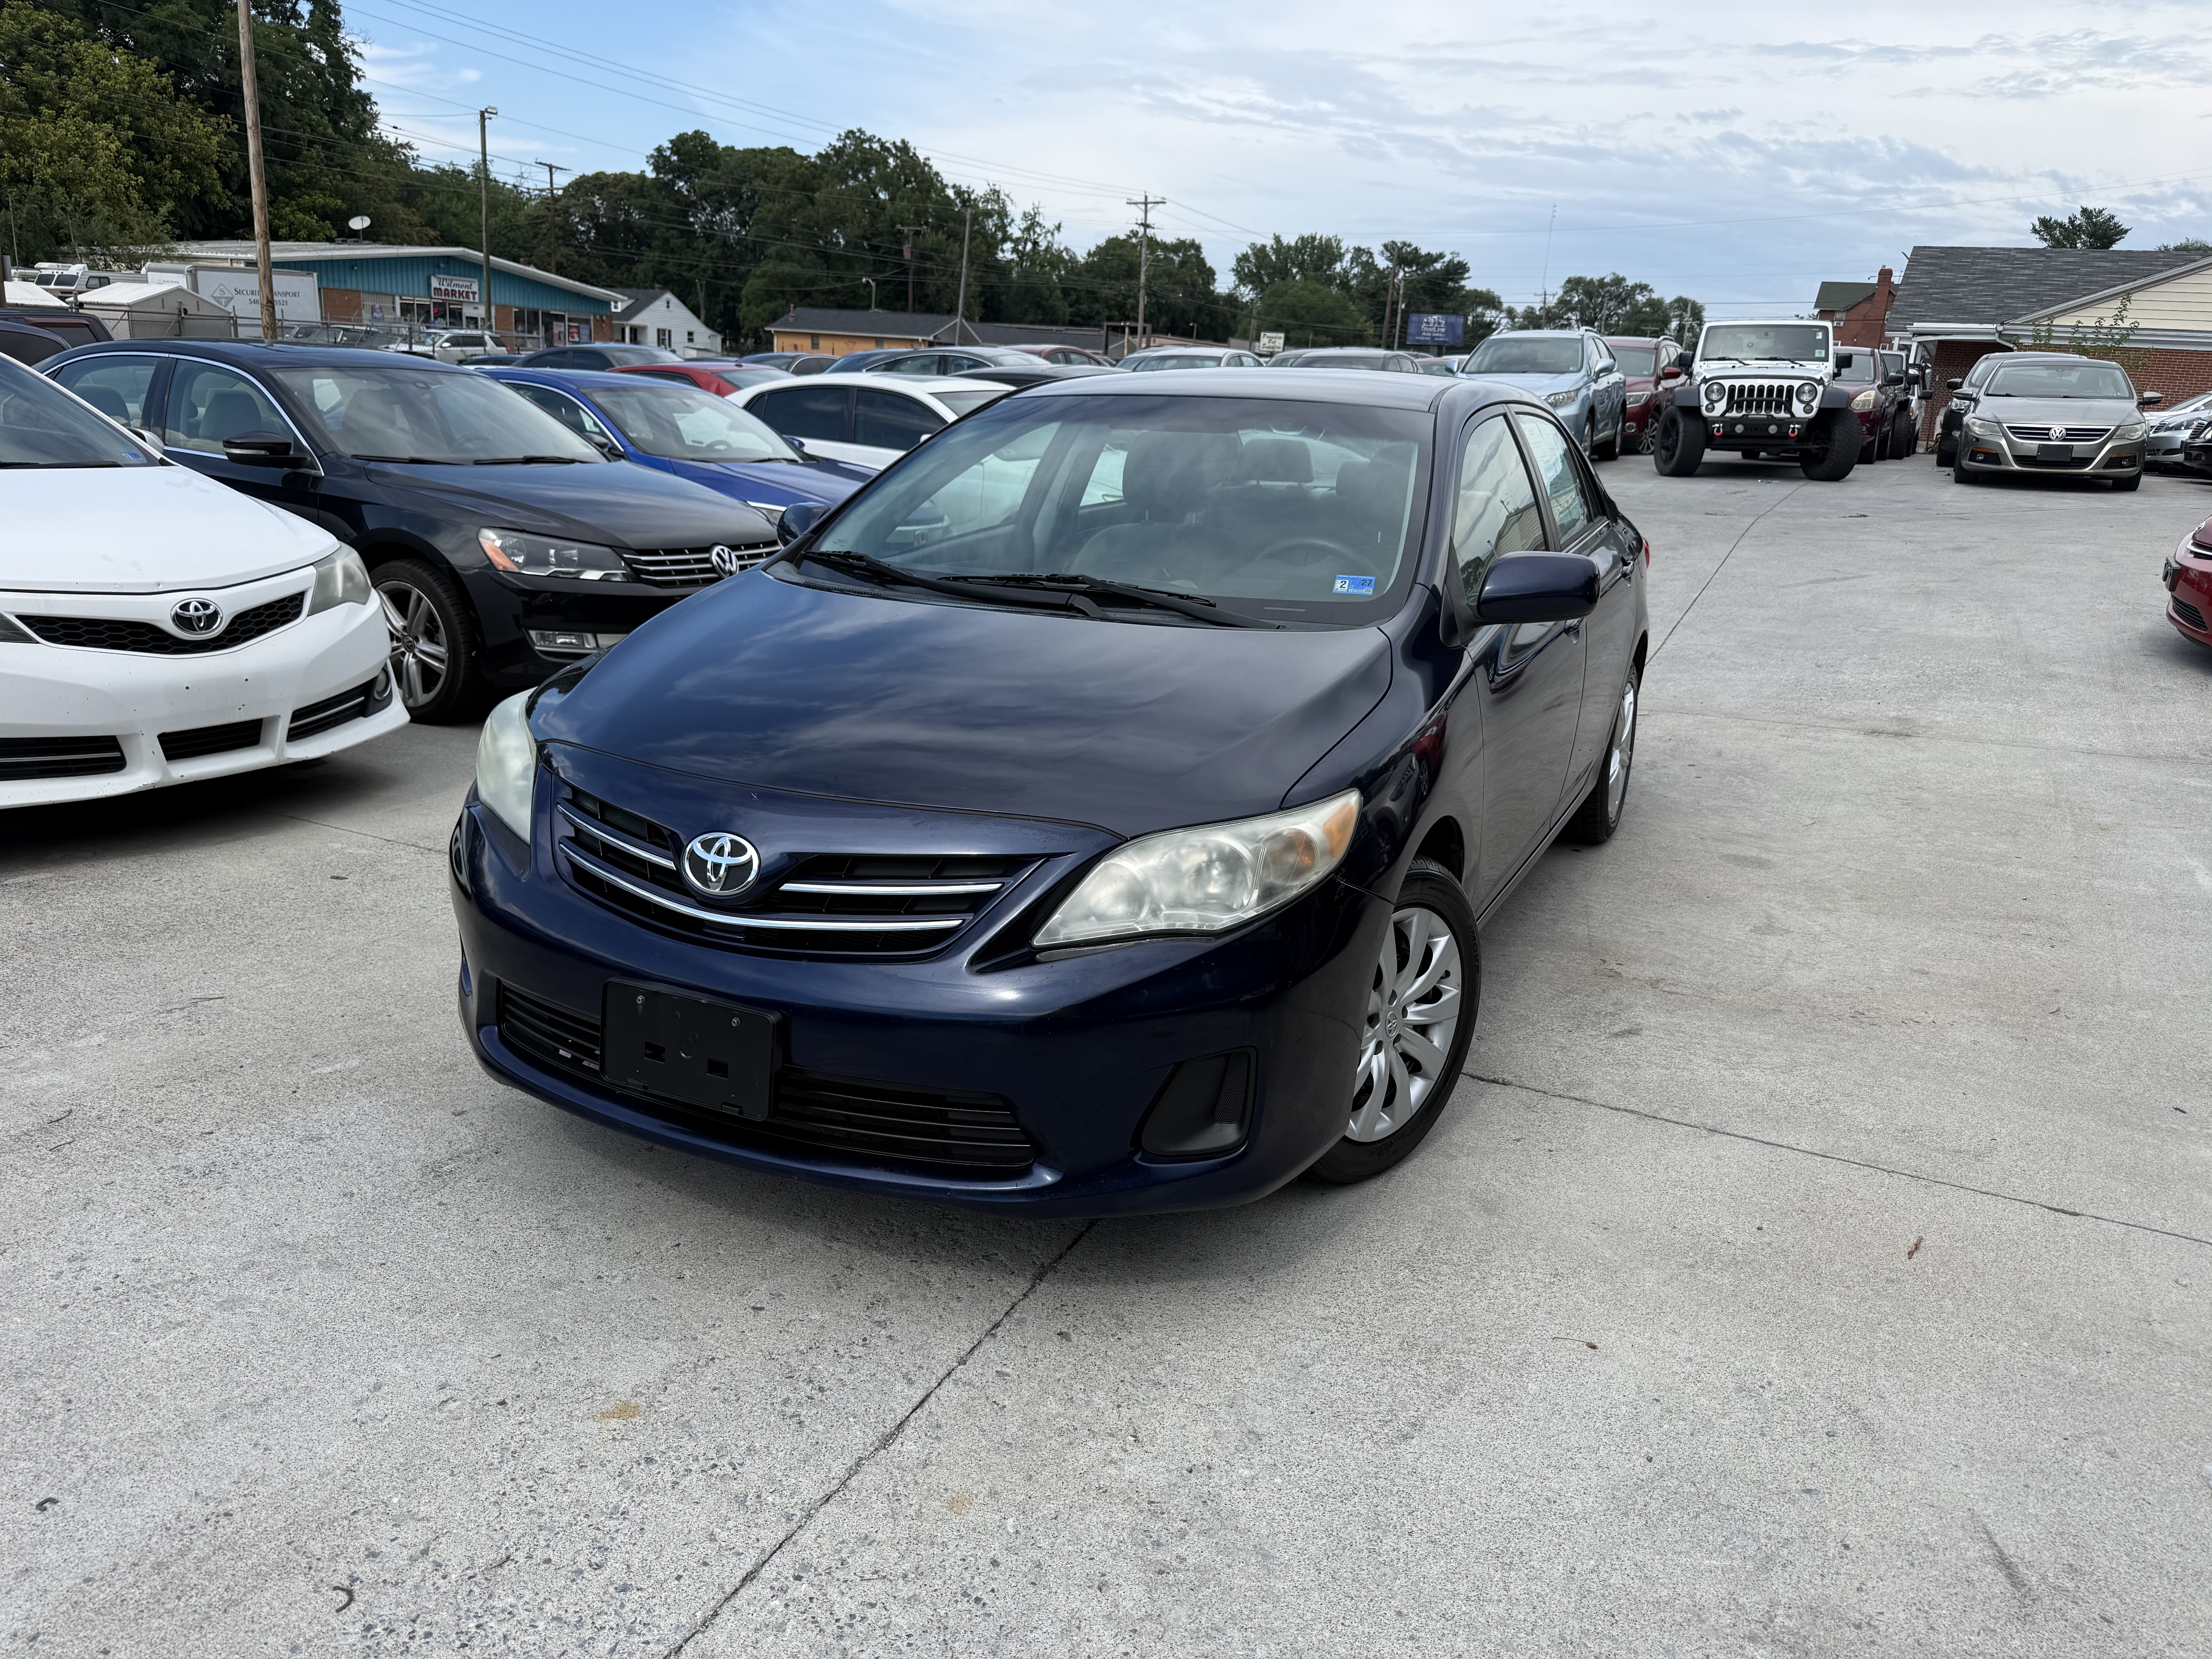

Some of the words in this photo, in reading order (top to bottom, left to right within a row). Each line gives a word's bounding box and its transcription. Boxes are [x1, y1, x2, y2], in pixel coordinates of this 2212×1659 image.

[437, 277, 472, 289] Wilmont
[234, 287, 259, 296] SECURIT
[433, 287, 477, 301] MARKET
